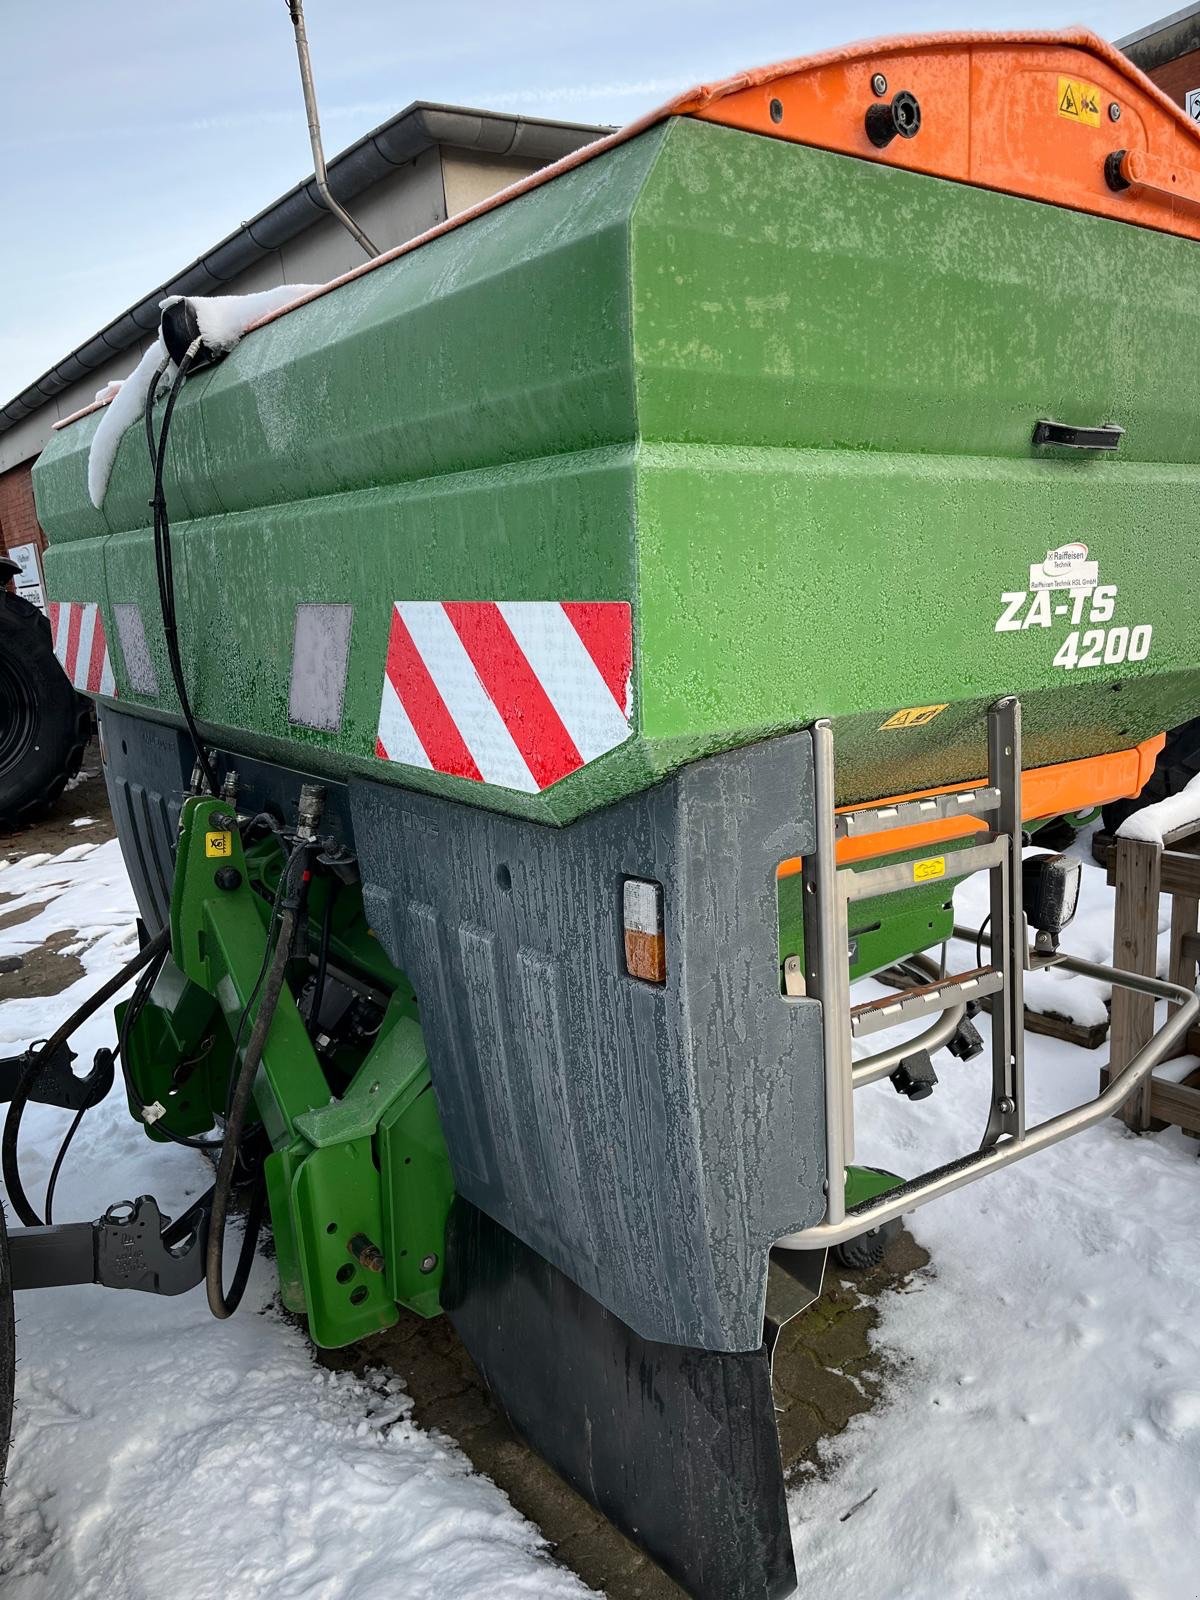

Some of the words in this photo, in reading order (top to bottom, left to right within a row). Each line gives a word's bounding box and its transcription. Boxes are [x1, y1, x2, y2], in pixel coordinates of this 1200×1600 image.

[1053, 551, 1084, 560] Raiffeisen
[1054, 561, 1072, 569] Technik
[995, 585, 1118, 632] ZA-TS
[1053, 624, 1153, 670] 4200
